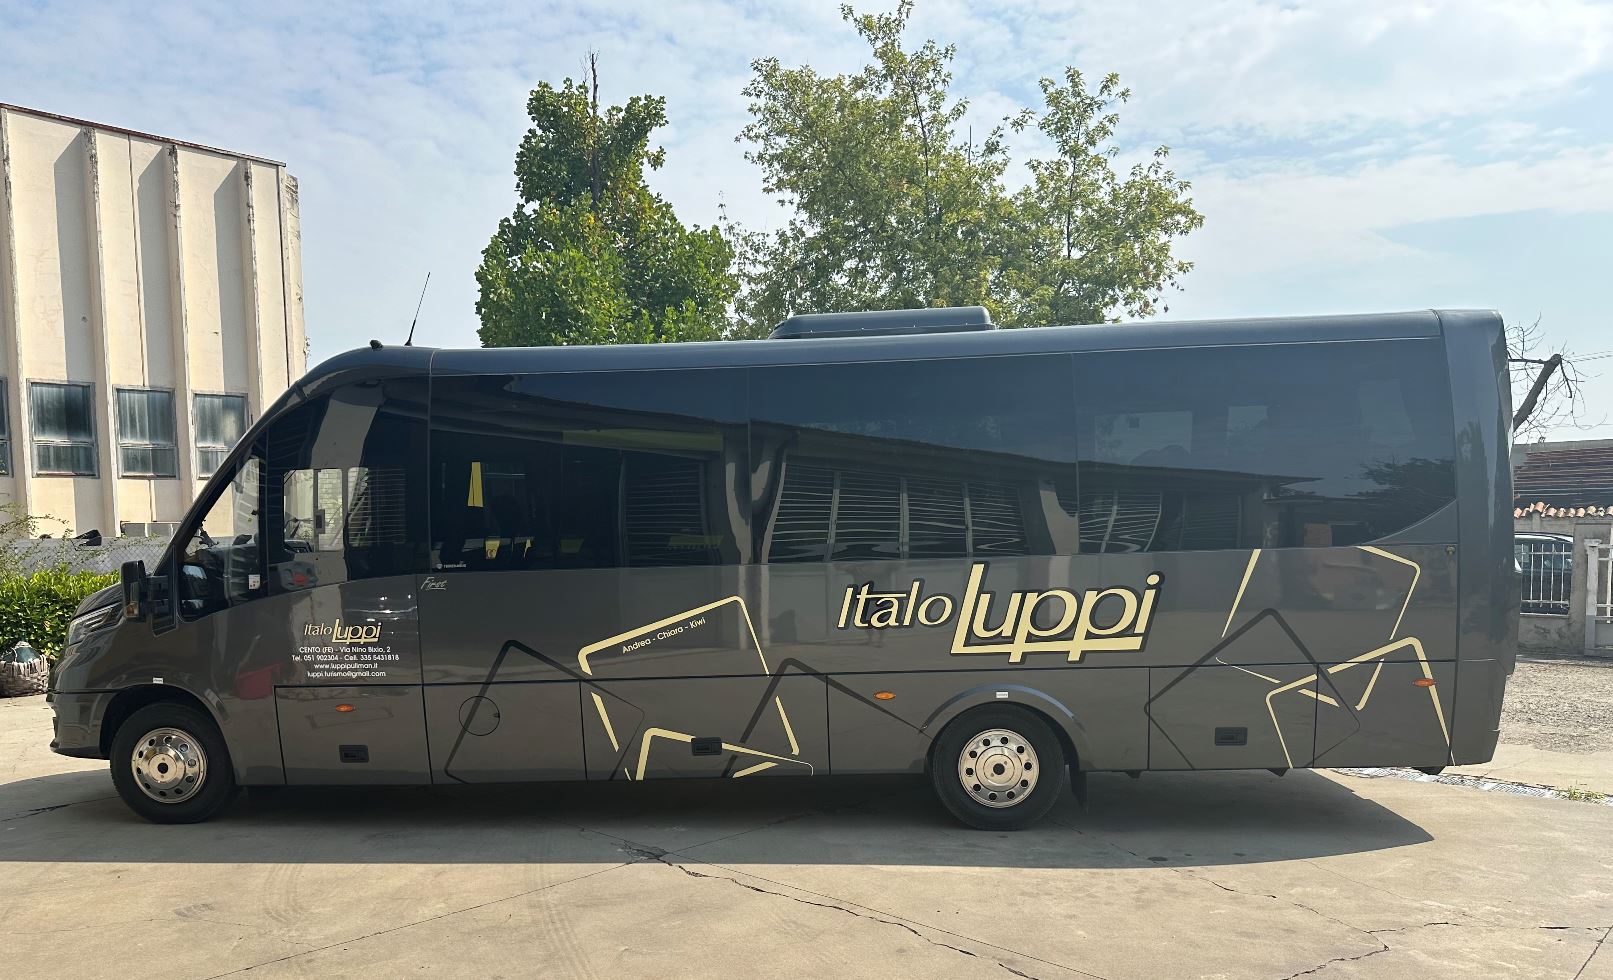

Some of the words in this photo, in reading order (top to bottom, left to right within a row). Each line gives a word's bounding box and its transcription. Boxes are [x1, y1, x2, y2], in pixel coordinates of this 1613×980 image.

[836, 580, 953, 629] Italo
[951, 562, 1161, 664] Luppi
[304, 622, 332, 636] Italo
[331, 618, 381, 645] Luppi
[622, 638, 652, 654] Andrea
[657, 627, 684, 640] Chiara
[689, 616, 706, 629] Kiwi
[291, 654, 303, 662] Tel.
[322, 646, 334, 654] (FE)
